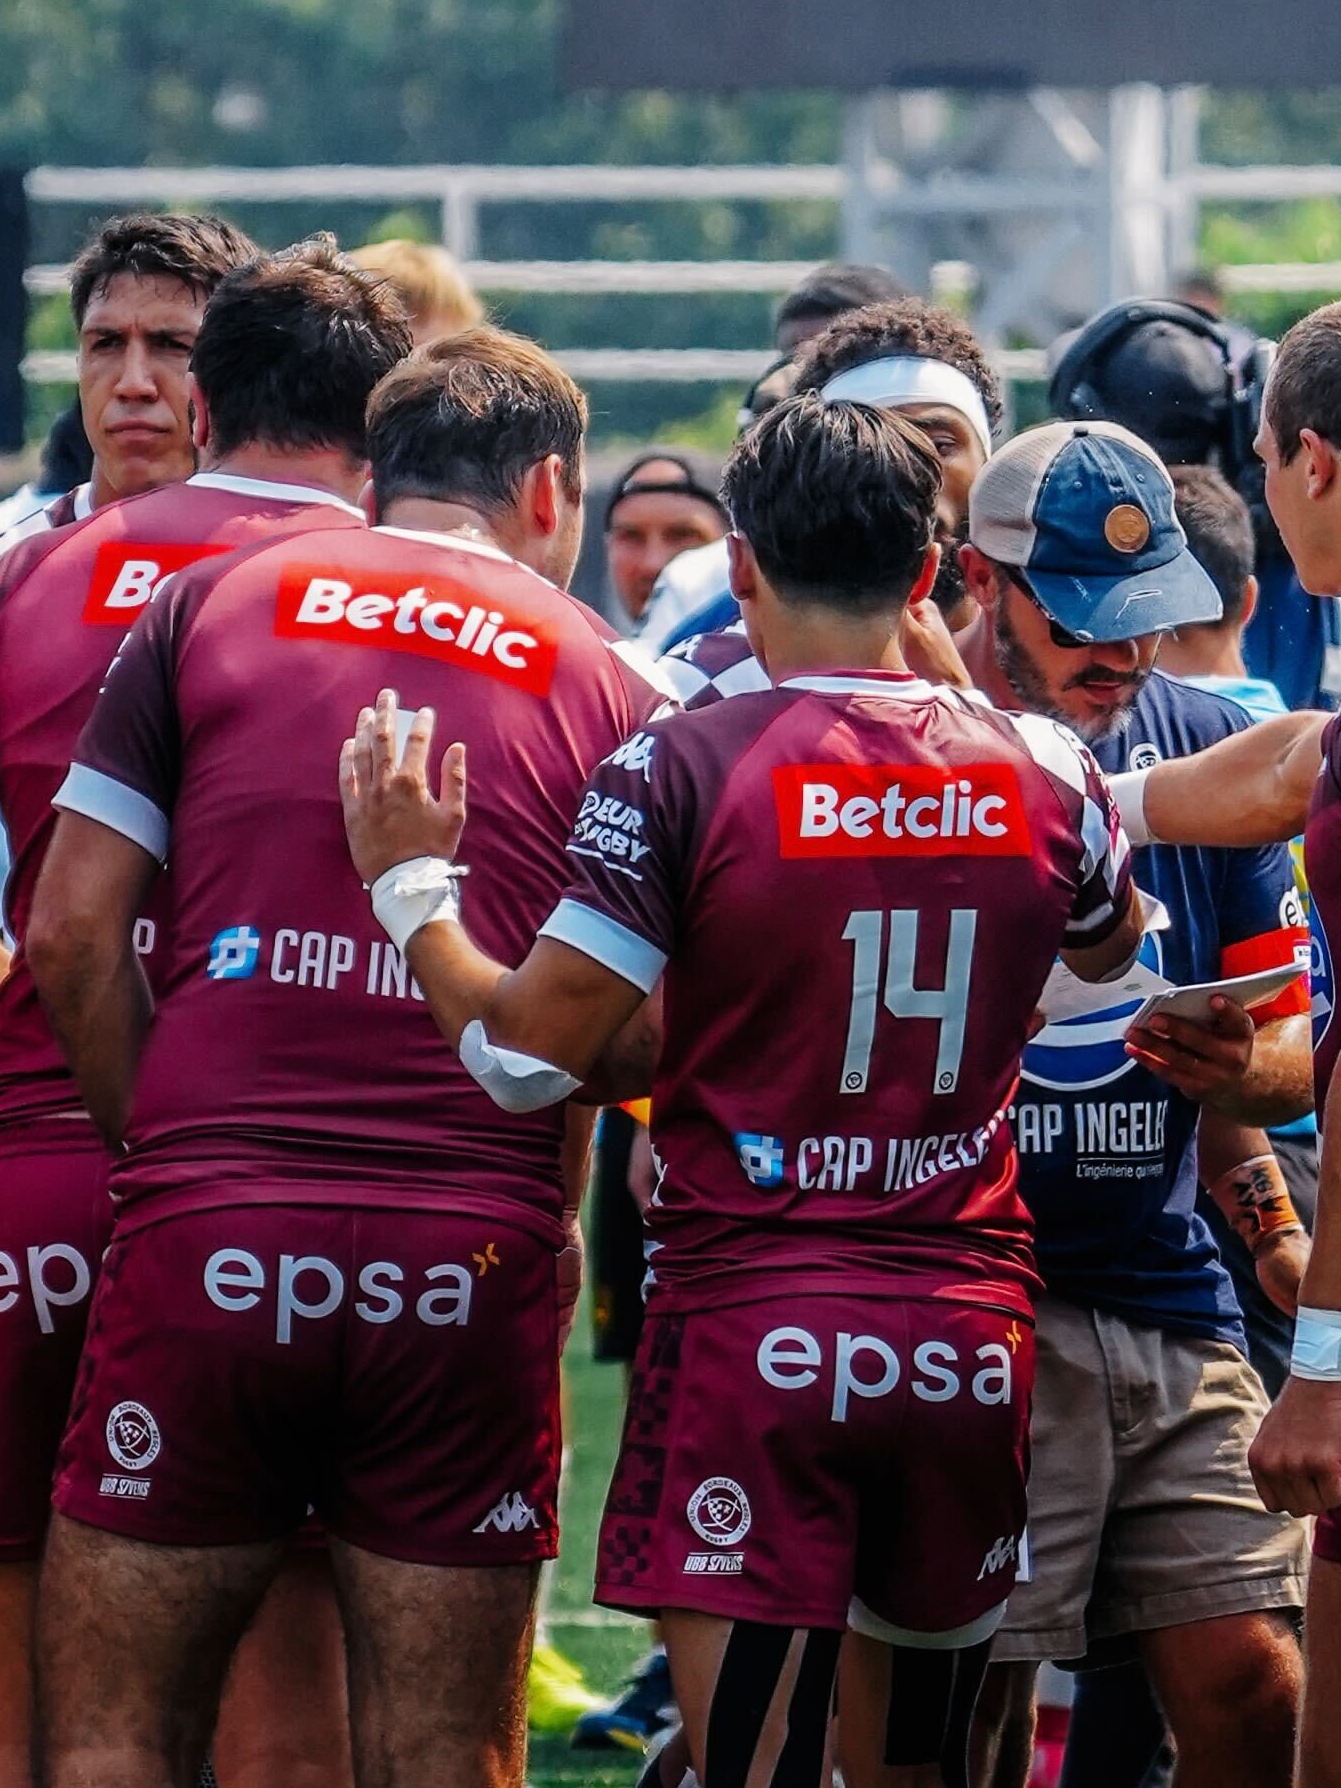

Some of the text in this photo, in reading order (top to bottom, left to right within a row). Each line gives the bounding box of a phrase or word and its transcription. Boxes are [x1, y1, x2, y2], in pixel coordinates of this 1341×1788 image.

[295, 577, 539, 670] Betclic
[799, 781, 1008, 840] Betclic
[269, 927, 354, 990] CAP
[842, 909, 979, 1095] 14
[797, 1135, 872, 1191] CAP
[204, 1246, 471, 1344] epsa
[758, 1326, 1012, 1422] epsa
